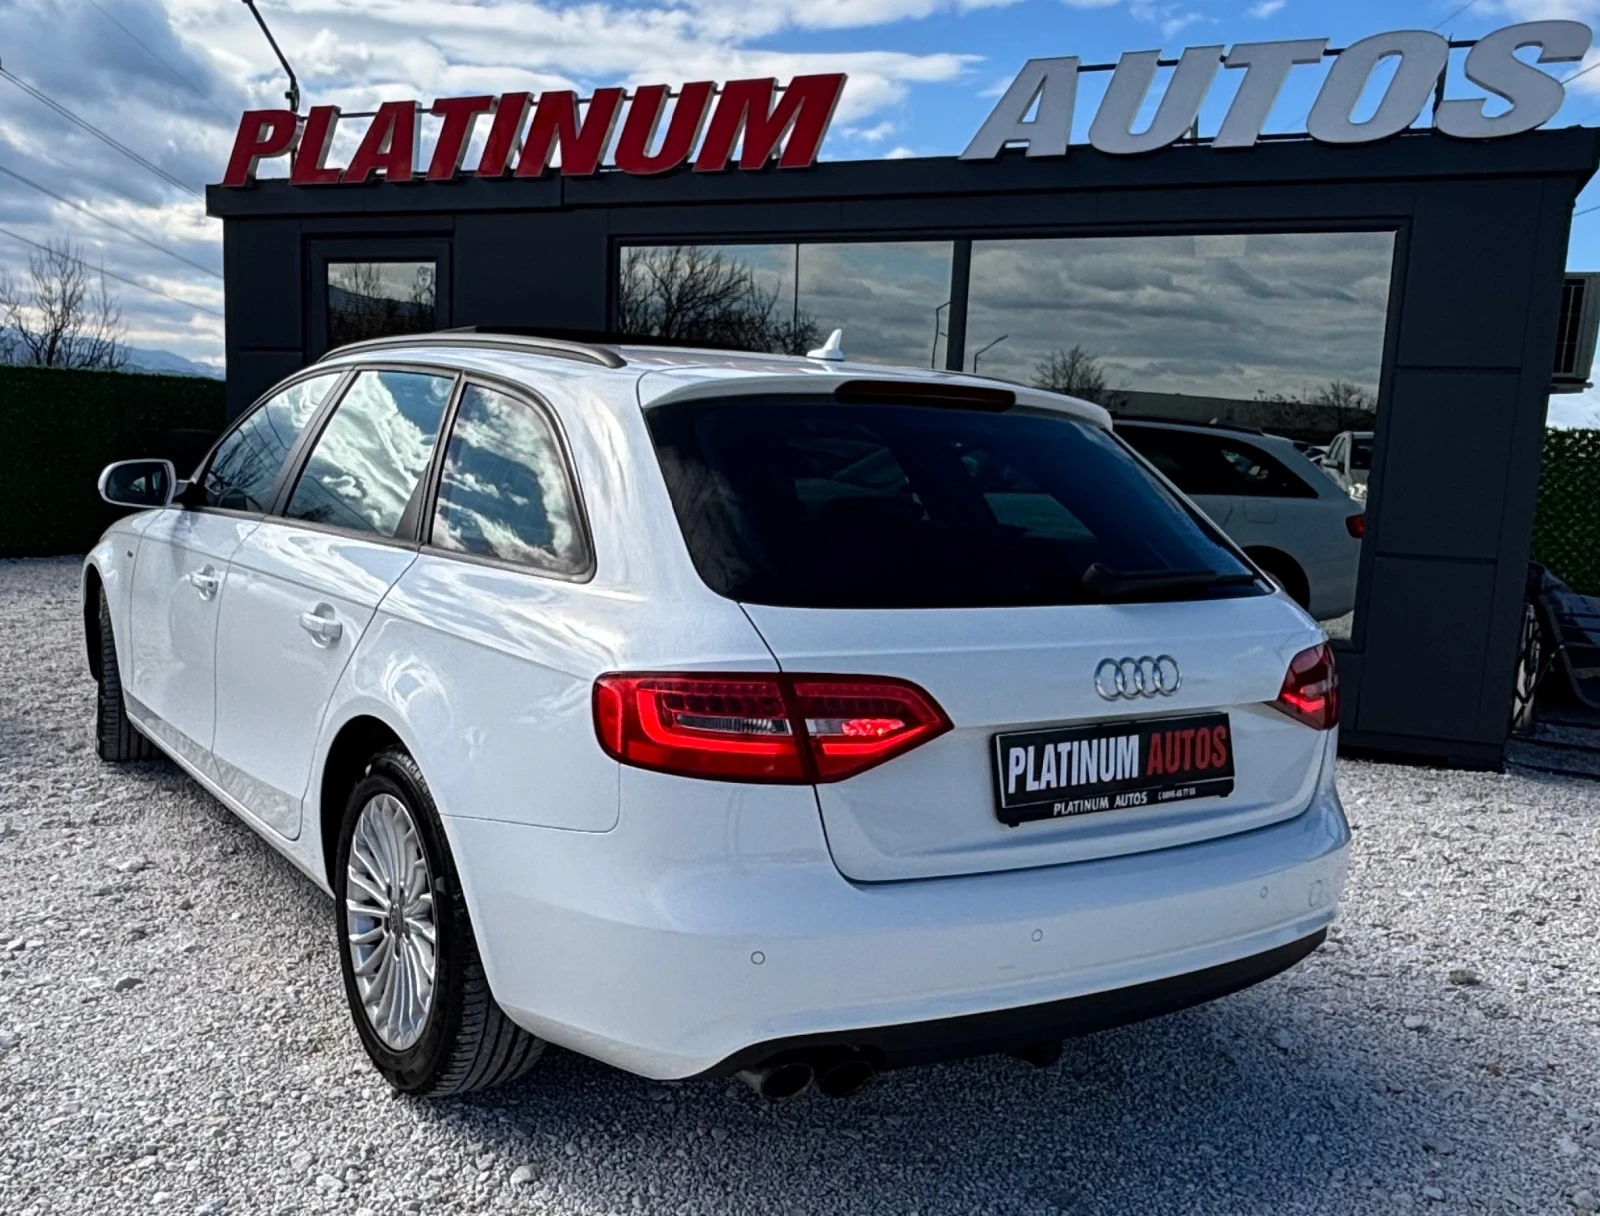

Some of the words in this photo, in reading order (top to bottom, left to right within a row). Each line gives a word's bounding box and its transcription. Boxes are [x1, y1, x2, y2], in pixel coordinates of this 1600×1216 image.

[221, 72, 848, 187] PLATINUM
[958, 20, 1592, 161] AUTOS
[1008, 734, 1140, 794] PLATINUM
[1146, 725, 1227, 776] AUTOS
[1053, 796, 1109, 816] PLATINUM
[1113, 791, 1148, 809] AUTOS
